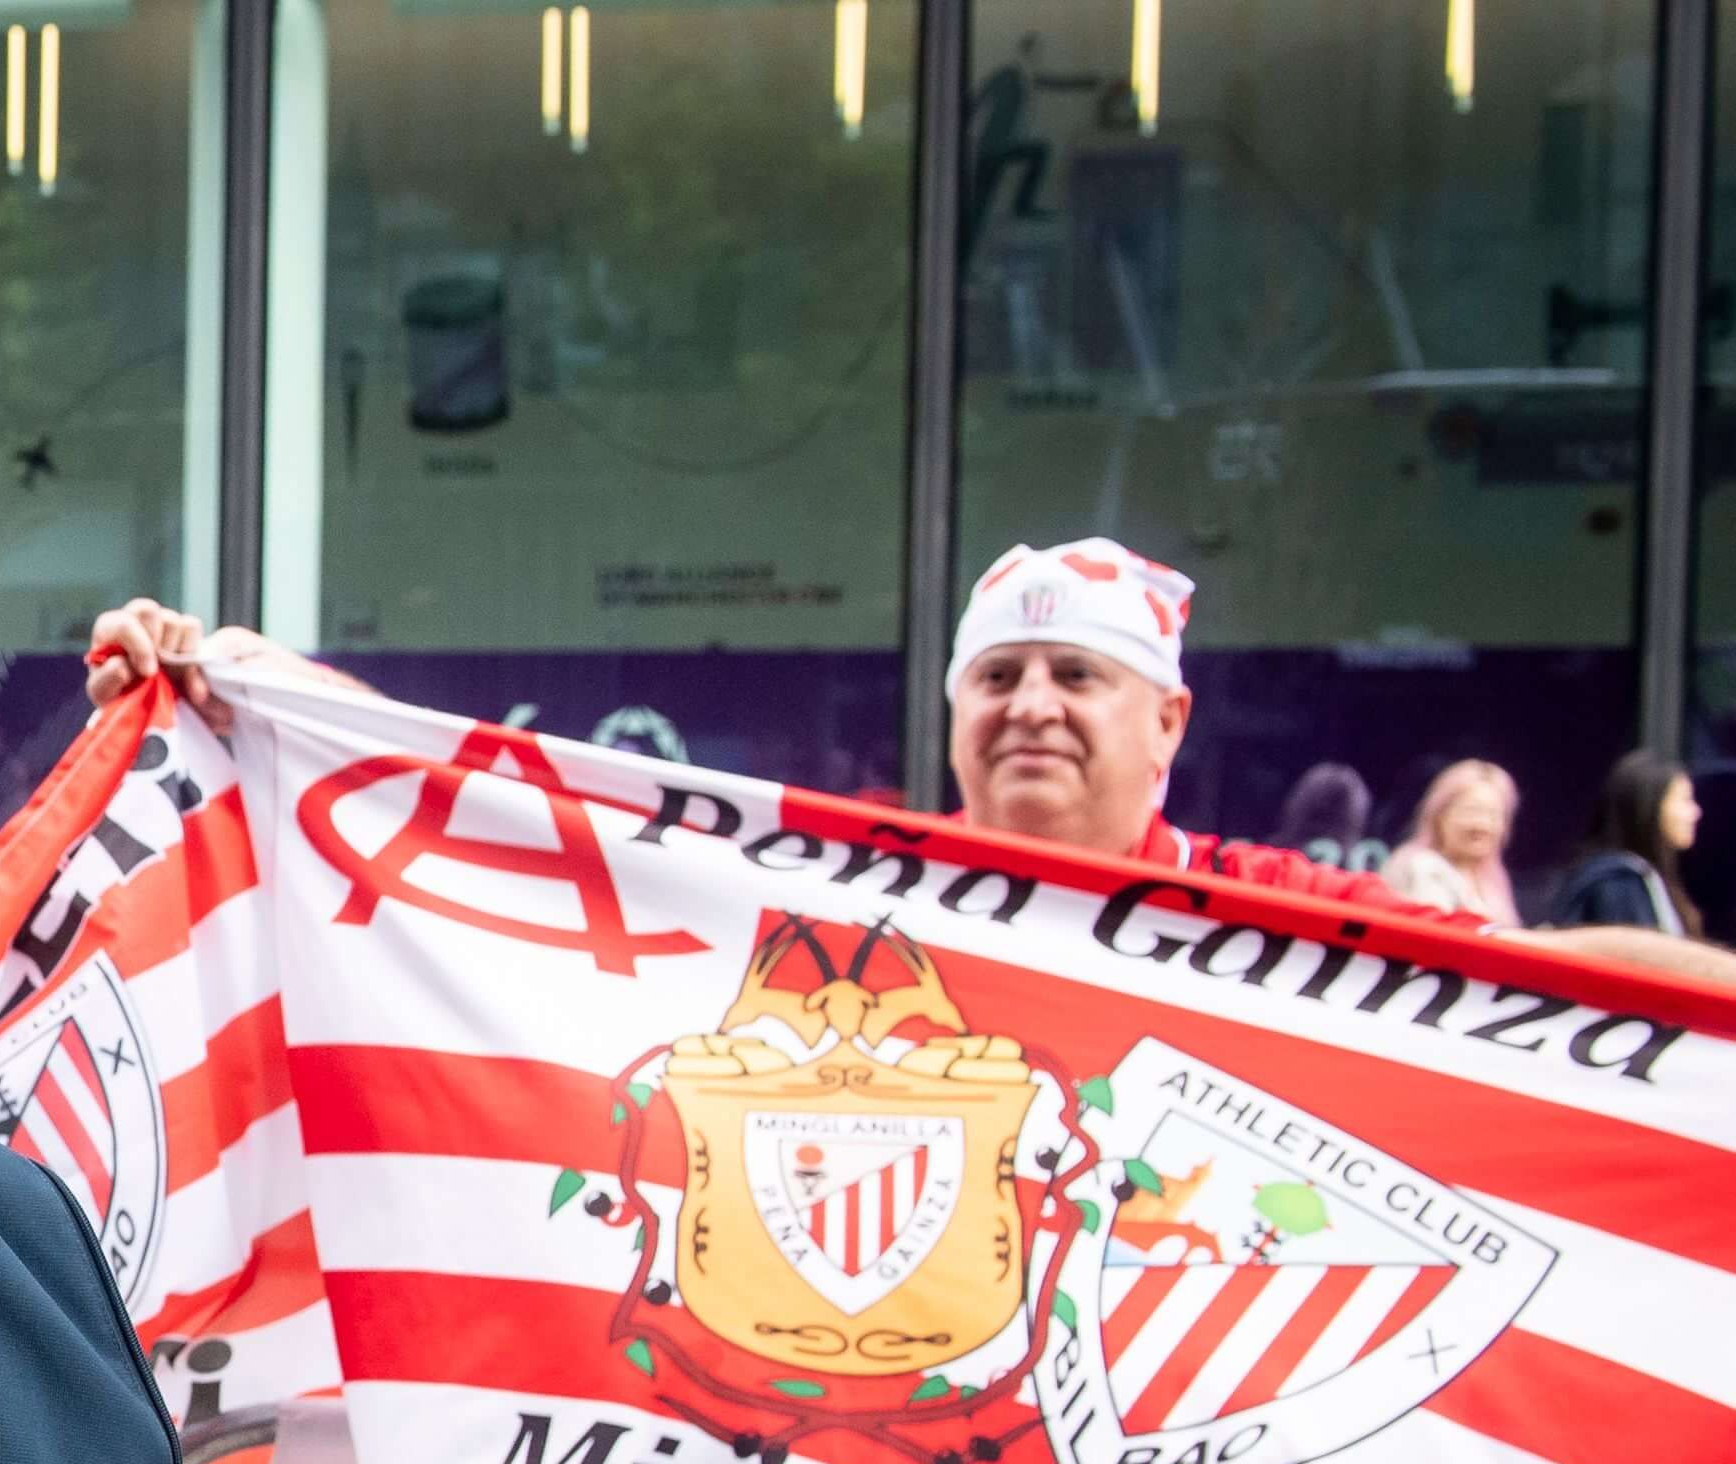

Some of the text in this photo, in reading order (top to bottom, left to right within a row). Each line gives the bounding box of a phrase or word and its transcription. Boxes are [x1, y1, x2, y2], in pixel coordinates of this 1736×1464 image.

[630, 784, 1689, 1086] Peña Gainza
[1158, 1069, 1508, 1267] ATHLETIC CLUB
